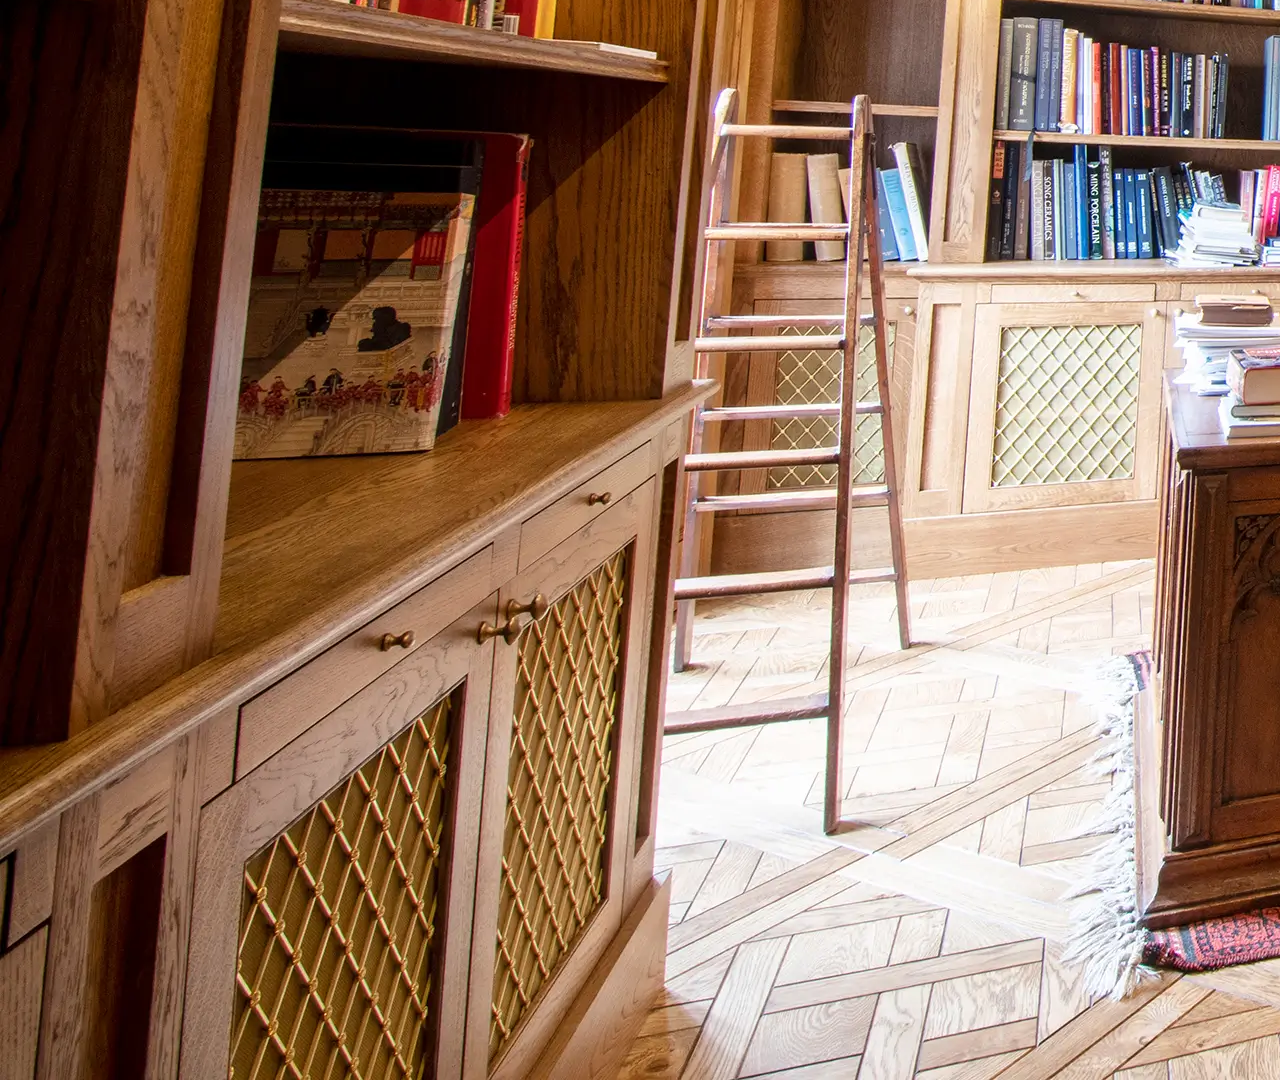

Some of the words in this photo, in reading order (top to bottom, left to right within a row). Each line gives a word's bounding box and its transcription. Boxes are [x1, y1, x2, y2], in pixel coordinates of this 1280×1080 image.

[1044, 176, 1052, 199] SONG
[1090, 173, 1099, 196] MING
[1044, 200, 1053, 241] CERAMICS
[1091, 198, 1100, 244] PORCELAIN
